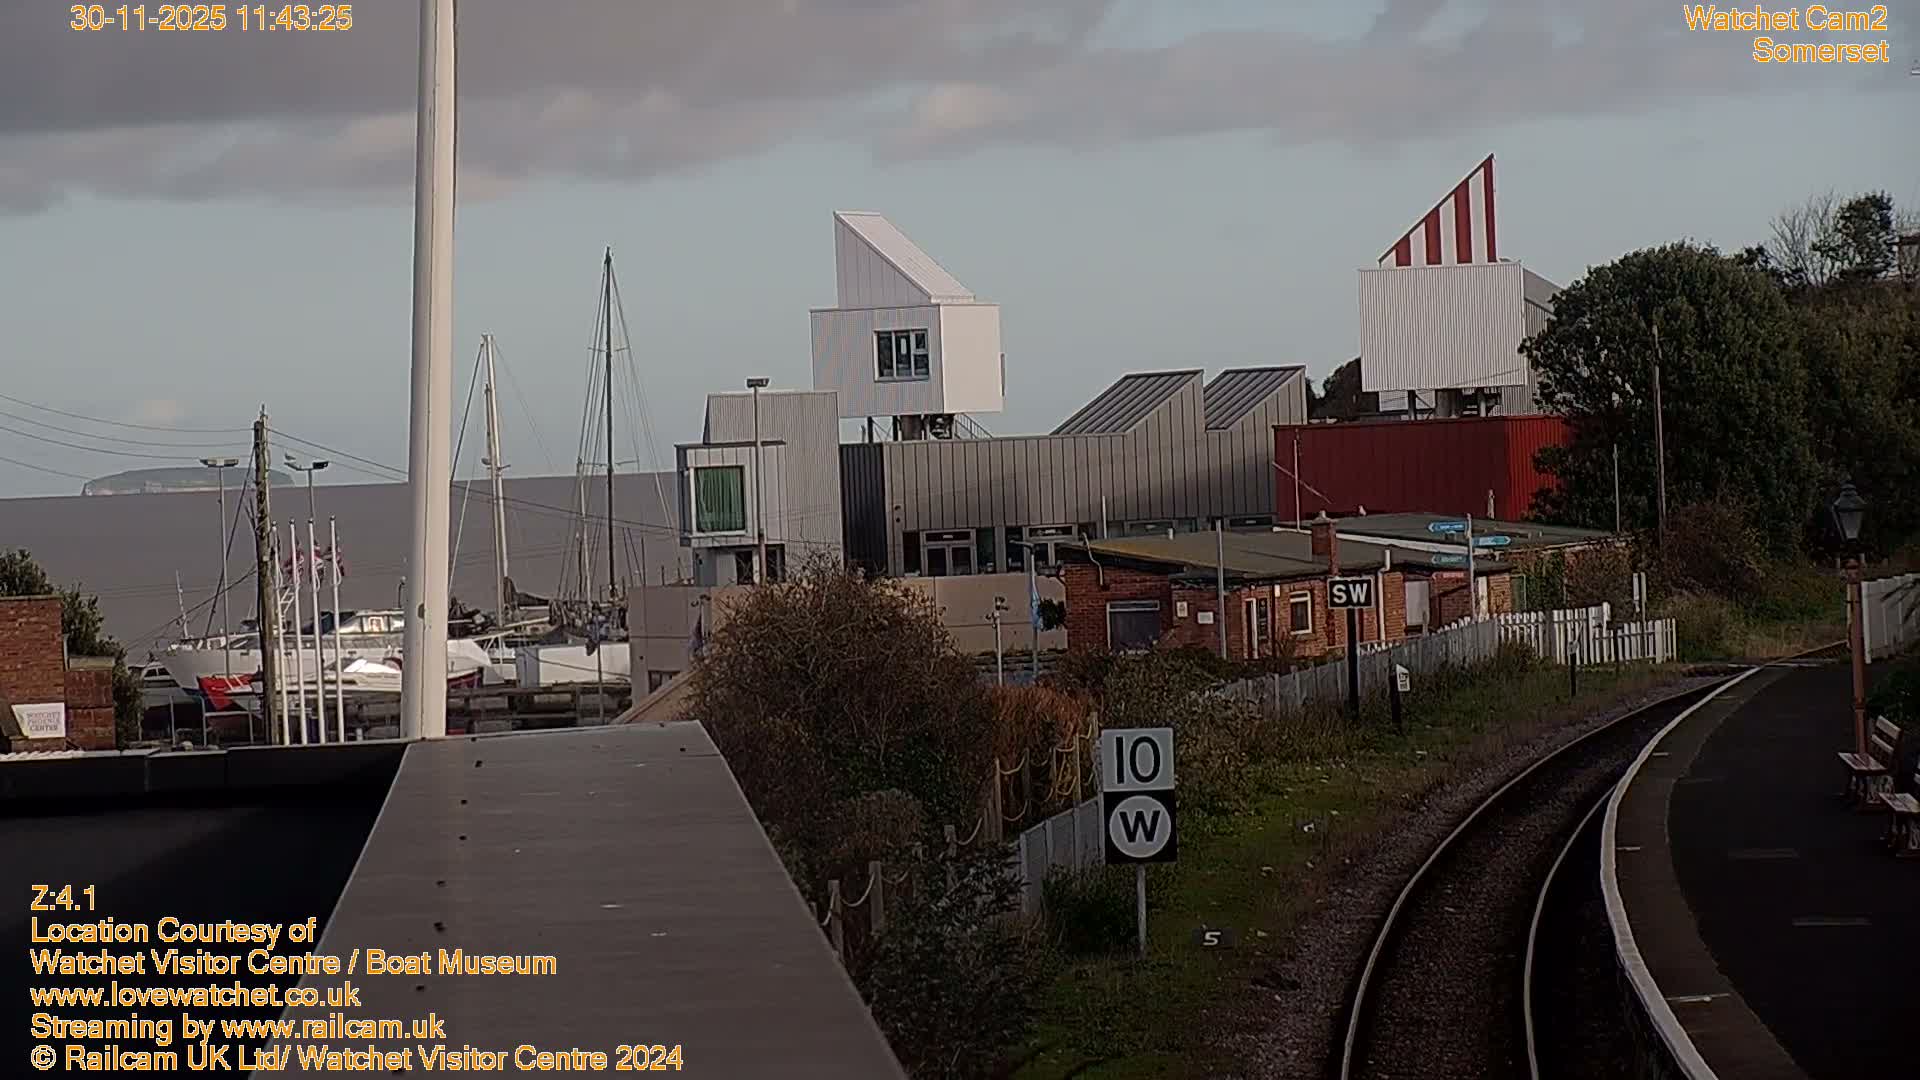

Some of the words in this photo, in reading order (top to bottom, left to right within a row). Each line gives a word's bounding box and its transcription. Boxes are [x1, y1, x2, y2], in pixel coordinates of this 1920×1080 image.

[1332, 583, 1367, 604] SW
[1114, 736, 1161, 784] 10
[1118, 810, 1161, 843] W
